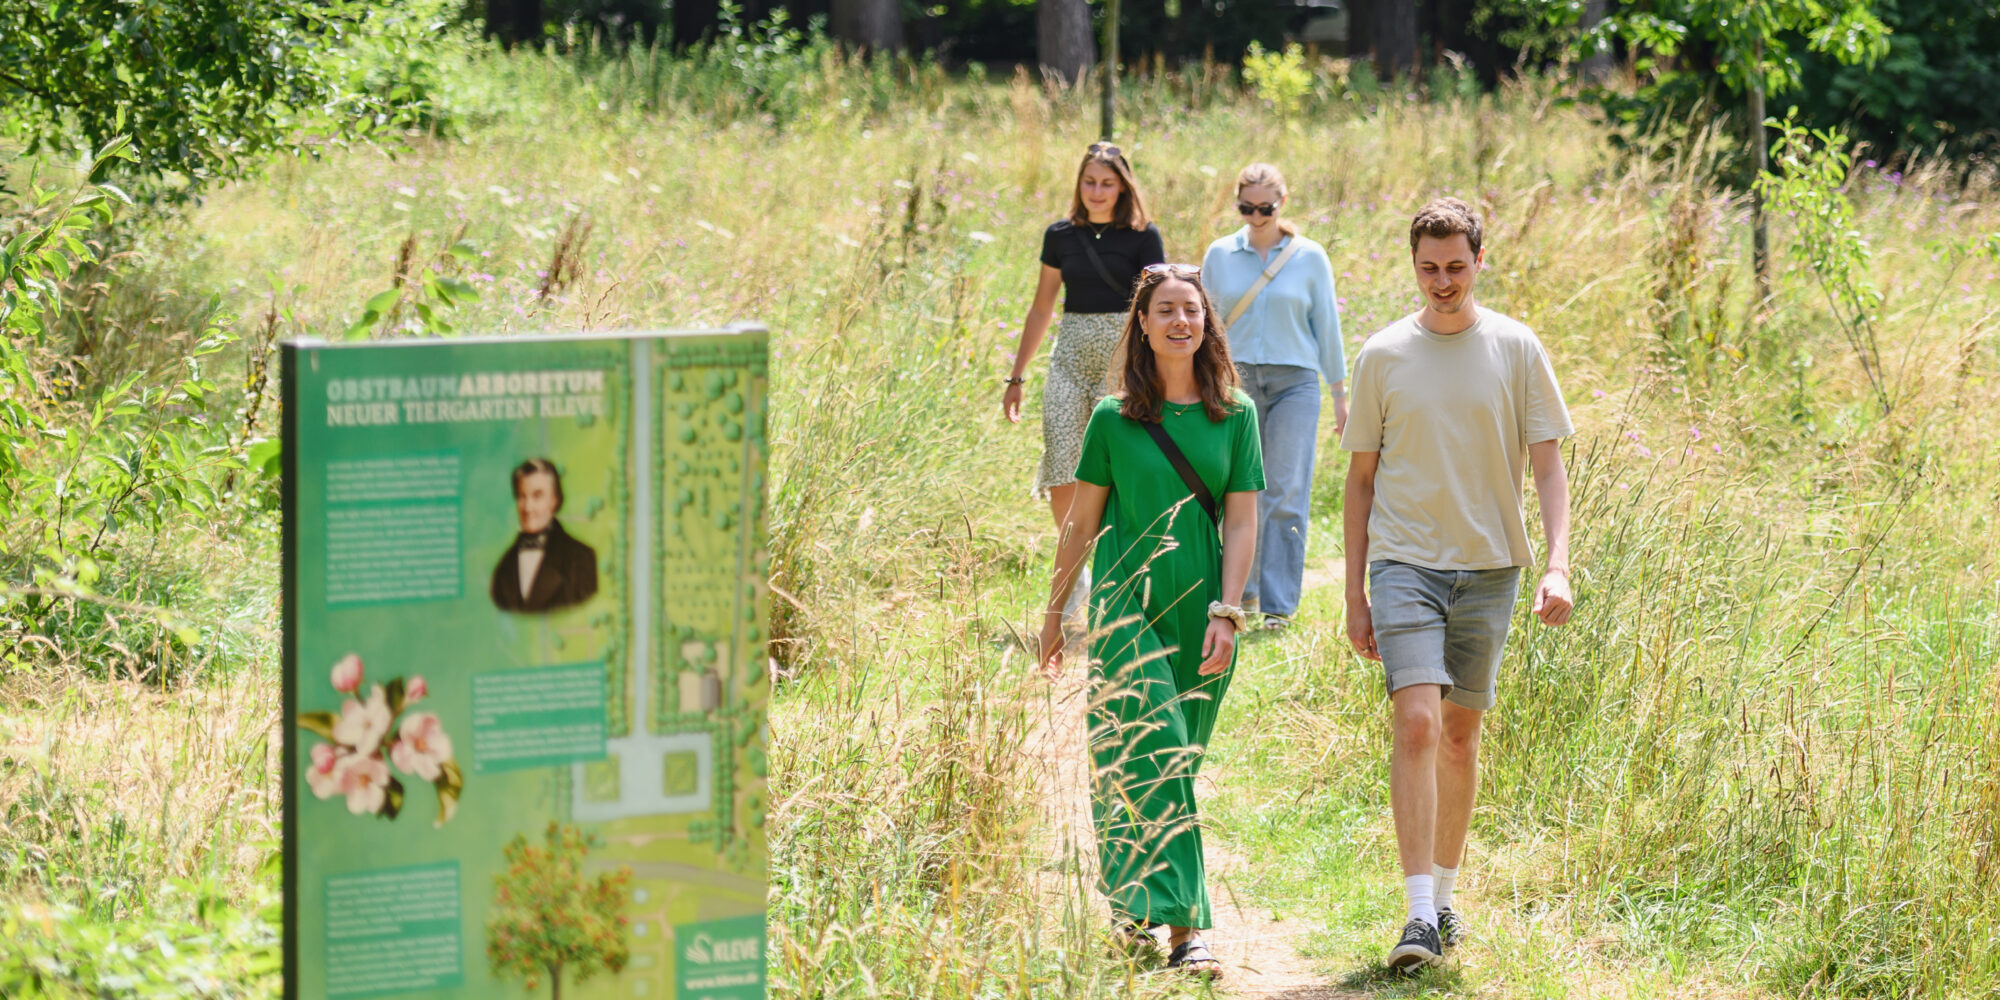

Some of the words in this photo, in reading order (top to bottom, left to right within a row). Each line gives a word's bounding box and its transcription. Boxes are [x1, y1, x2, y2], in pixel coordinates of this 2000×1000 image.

[326, 402, 398, 426] NEUER
[402, 398, 533, 423] TIERGARTEN
[540, 395, 606, 418] KLEVE
[713, 938, 759, 962] KLEVE
